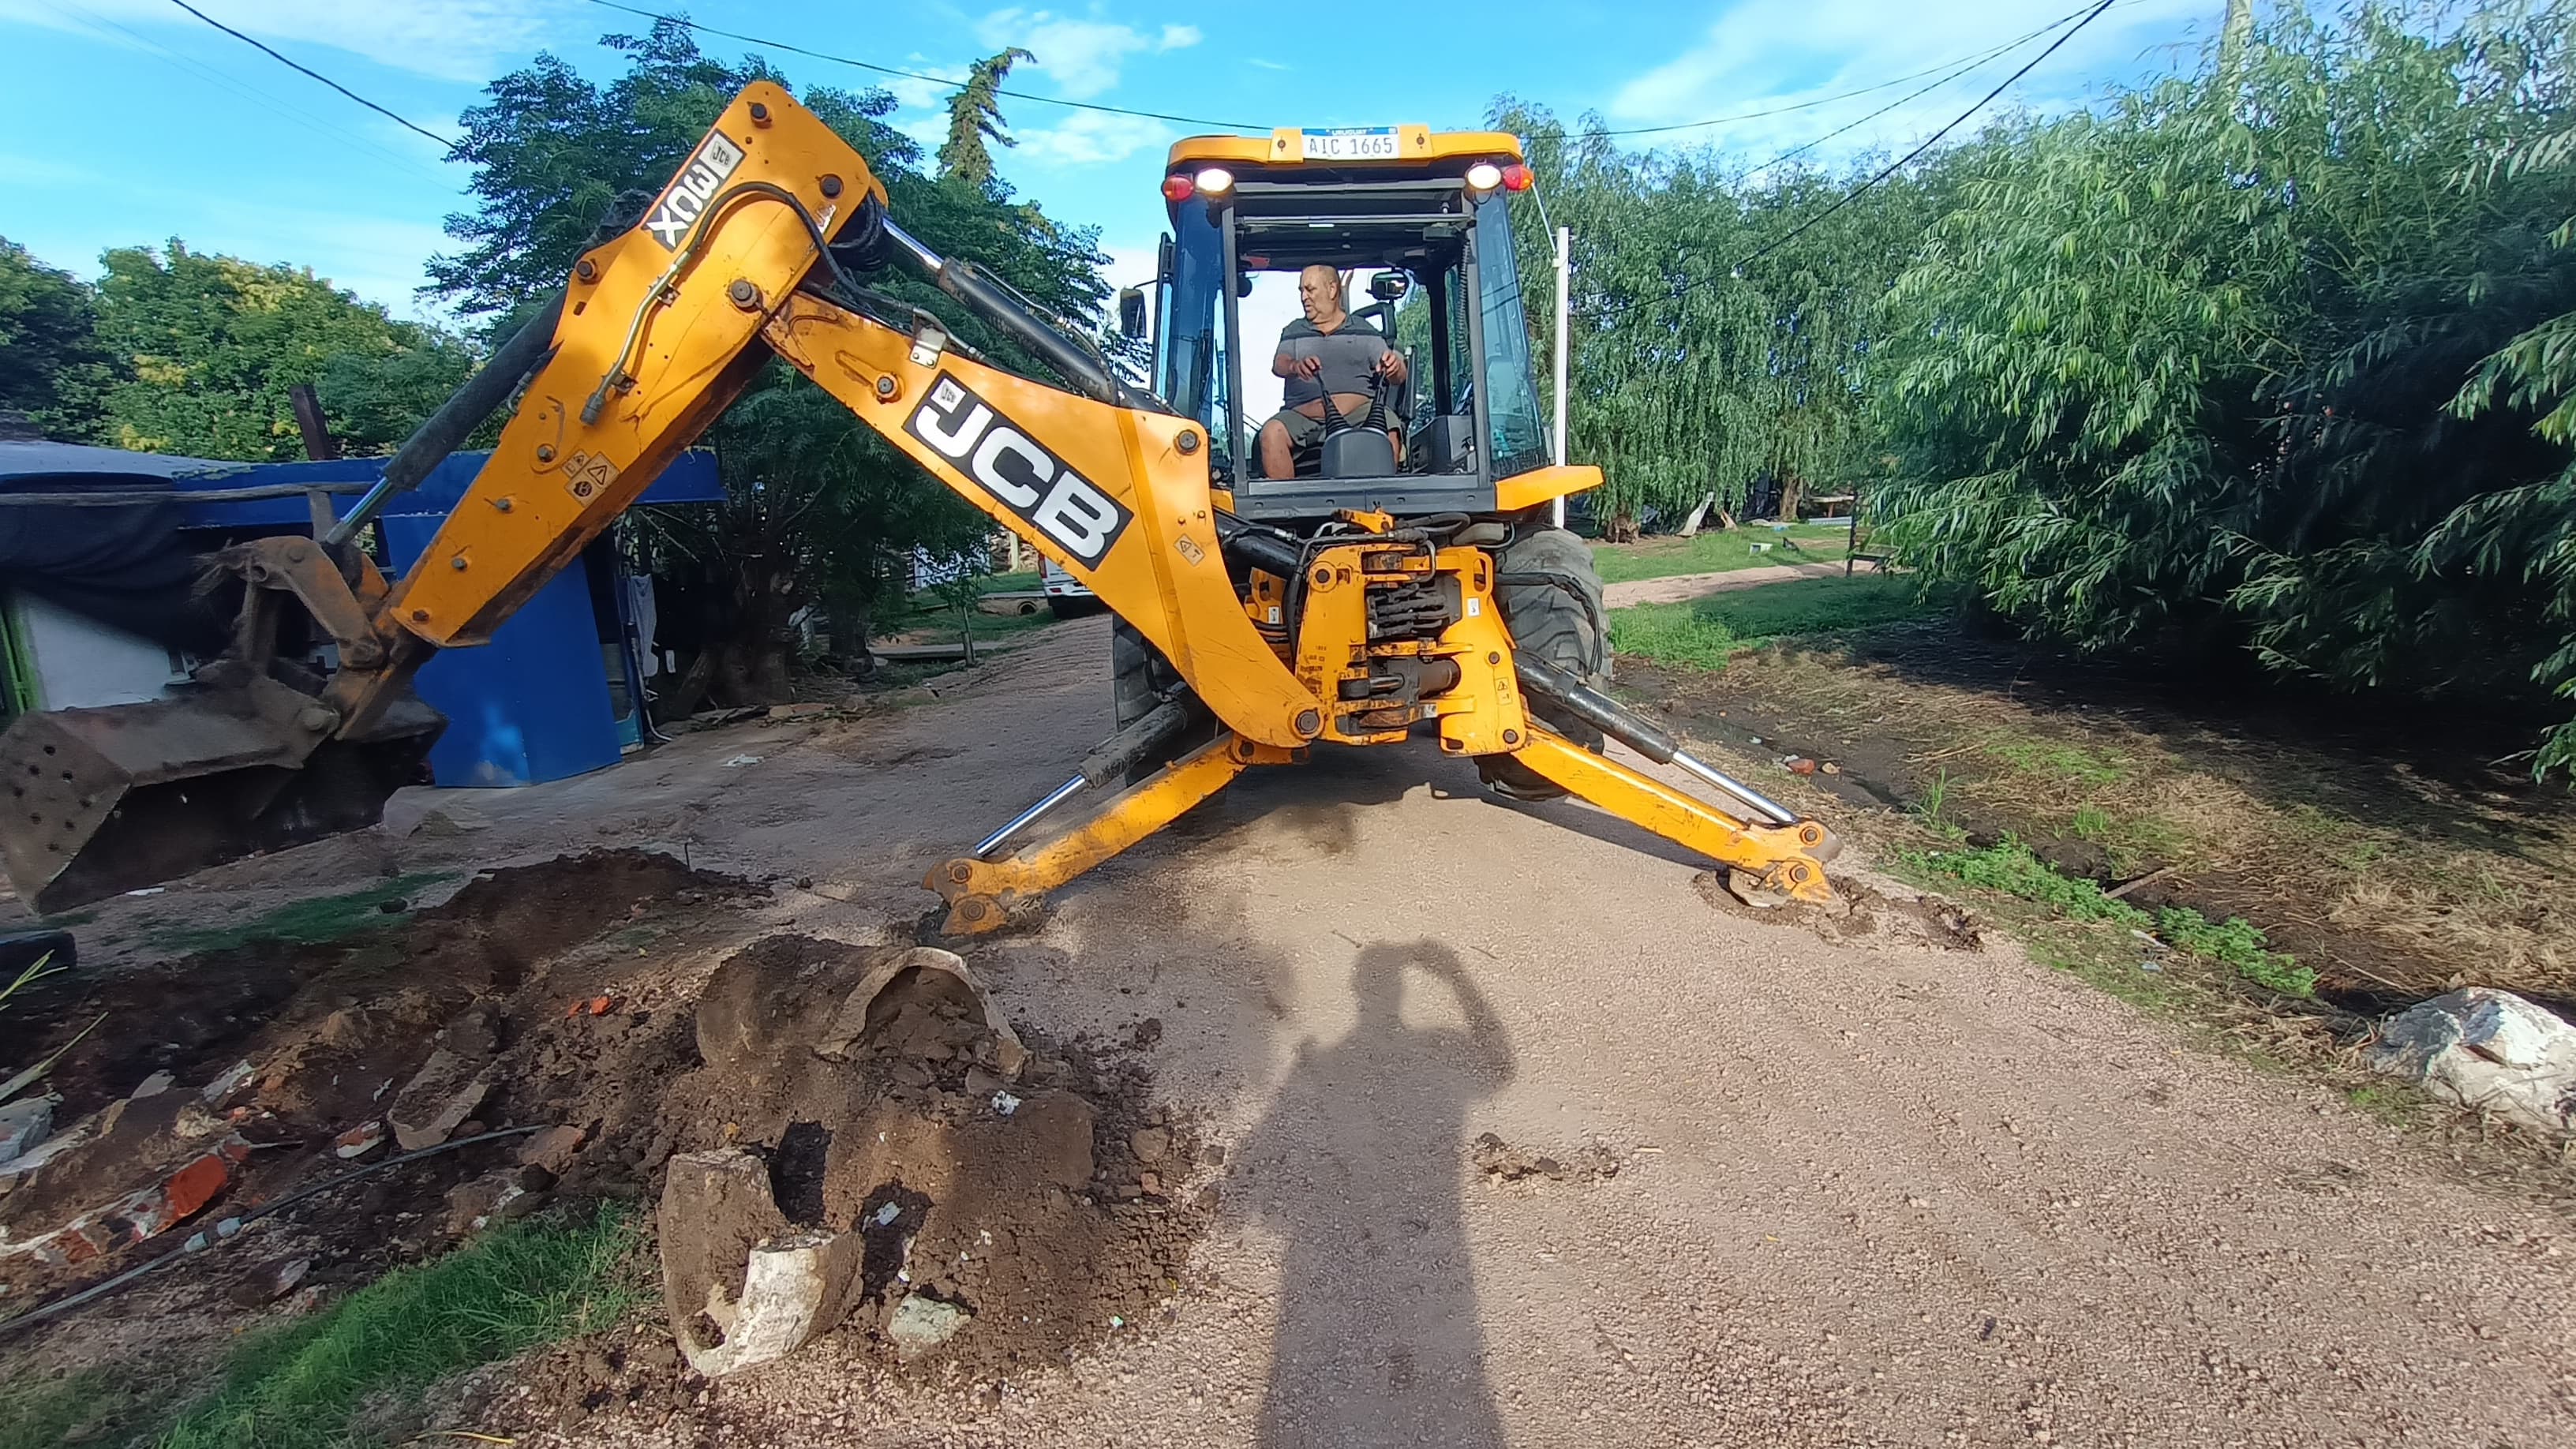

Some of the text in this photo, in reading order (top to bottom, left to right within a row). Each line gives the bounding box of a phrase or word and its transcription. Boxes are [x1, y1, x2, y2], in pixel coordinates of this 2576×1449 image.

[712, 144, 731, 166] JCB
[1309, 137, 1392, 154] AIC 1665
[646, 164, 719, 248] 3CX
[915, 402, 1120, 558] JCB
